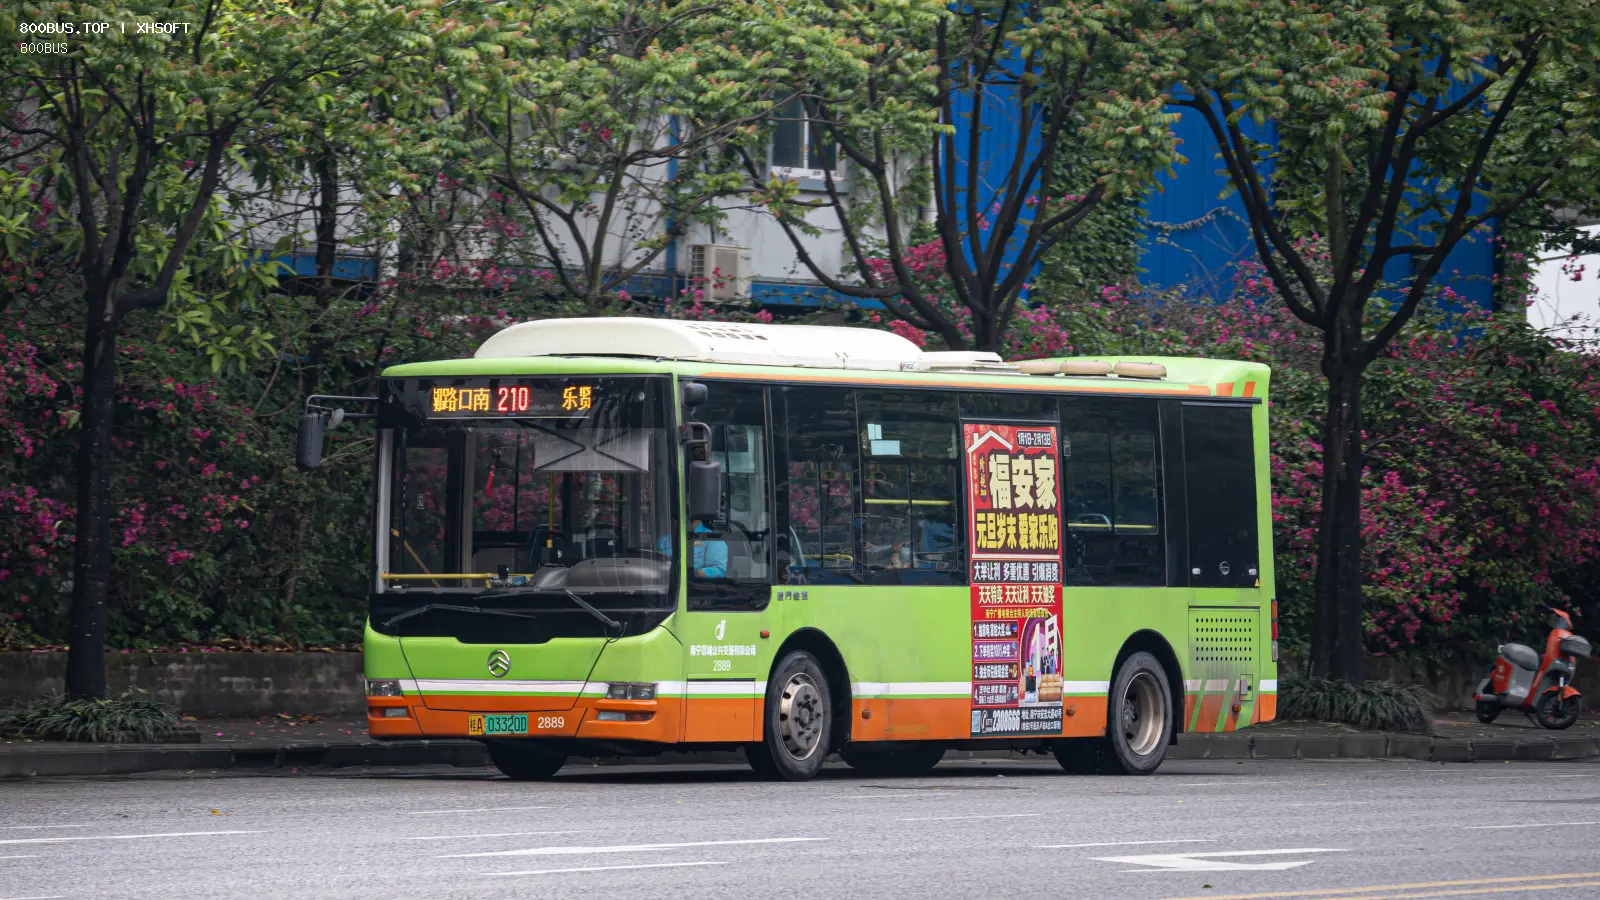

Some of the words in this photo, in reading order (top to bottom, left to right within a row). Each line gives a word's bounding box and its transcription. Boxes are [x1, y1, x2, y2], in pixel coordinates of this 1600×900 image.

[497, 387, 529, 412] 210
[1017, 432, 1051, 446] 1月1日-2月13日
[989, 454, 1057, 510] 福安家
[976, 512, 1017, 550] 元旦岁末
[1018, 512, 1059, 550] 爱家乐购
[974, 562, 1001, 581] 大举让利
[1003, 562, 1030, 581] 多重优惠
[1032, 562, 1059, 582] 引爆消费
[978, 585, 1003, 604] 天天特卖
[1005, 585, 1030, 604] 天天让利
[1031, 585, 1056, 604] 天天抽奖
[712, 659, 731, 672] 2889
[487, 717, 527, 732] 03320D
[537, 716, 565, 729] 2889
